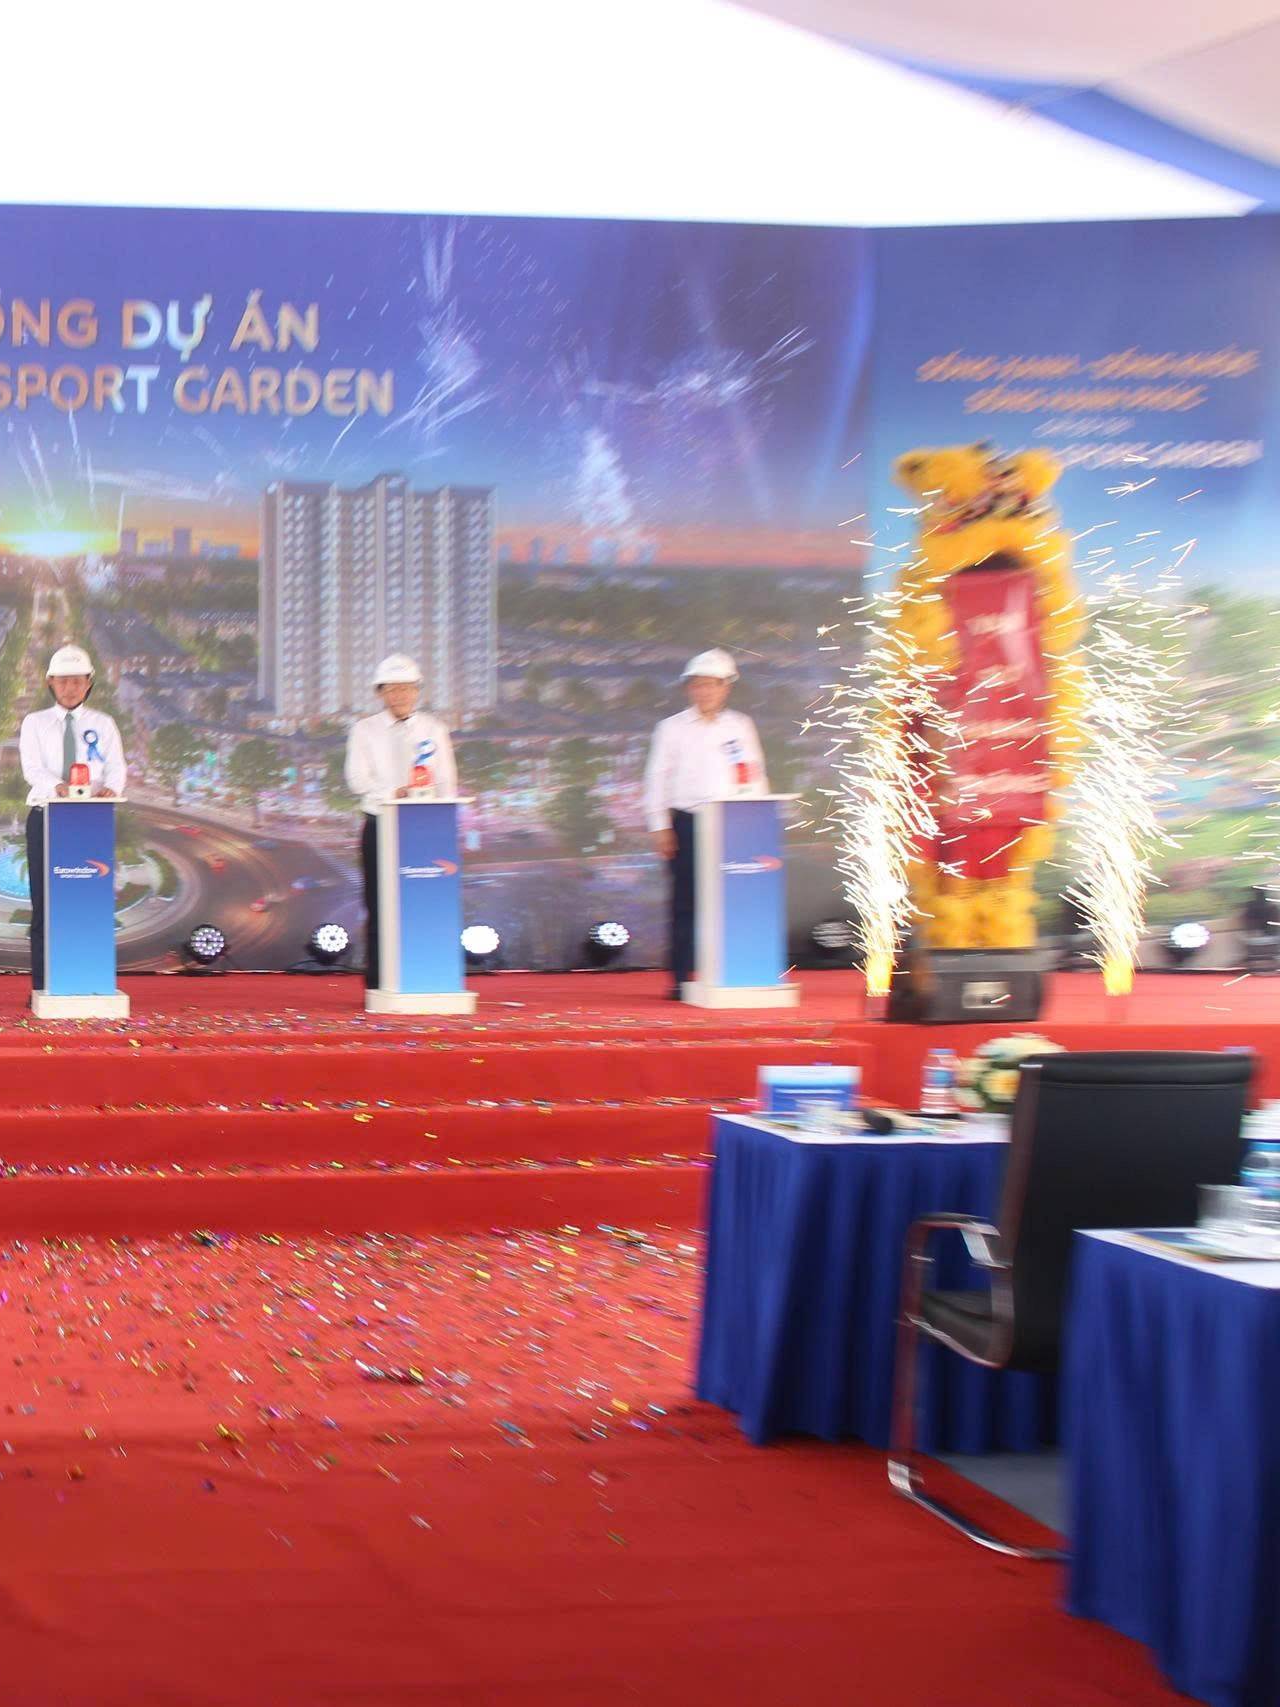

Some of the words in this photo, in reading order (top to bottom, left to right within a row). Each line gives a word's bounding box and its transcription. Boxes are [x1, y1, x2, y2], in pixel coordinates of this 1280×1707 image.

[122, 293, 213, 362] DỰ
[228, 288, 319, 352] ÁN
[173, 366, 395, 418] GARDEN
